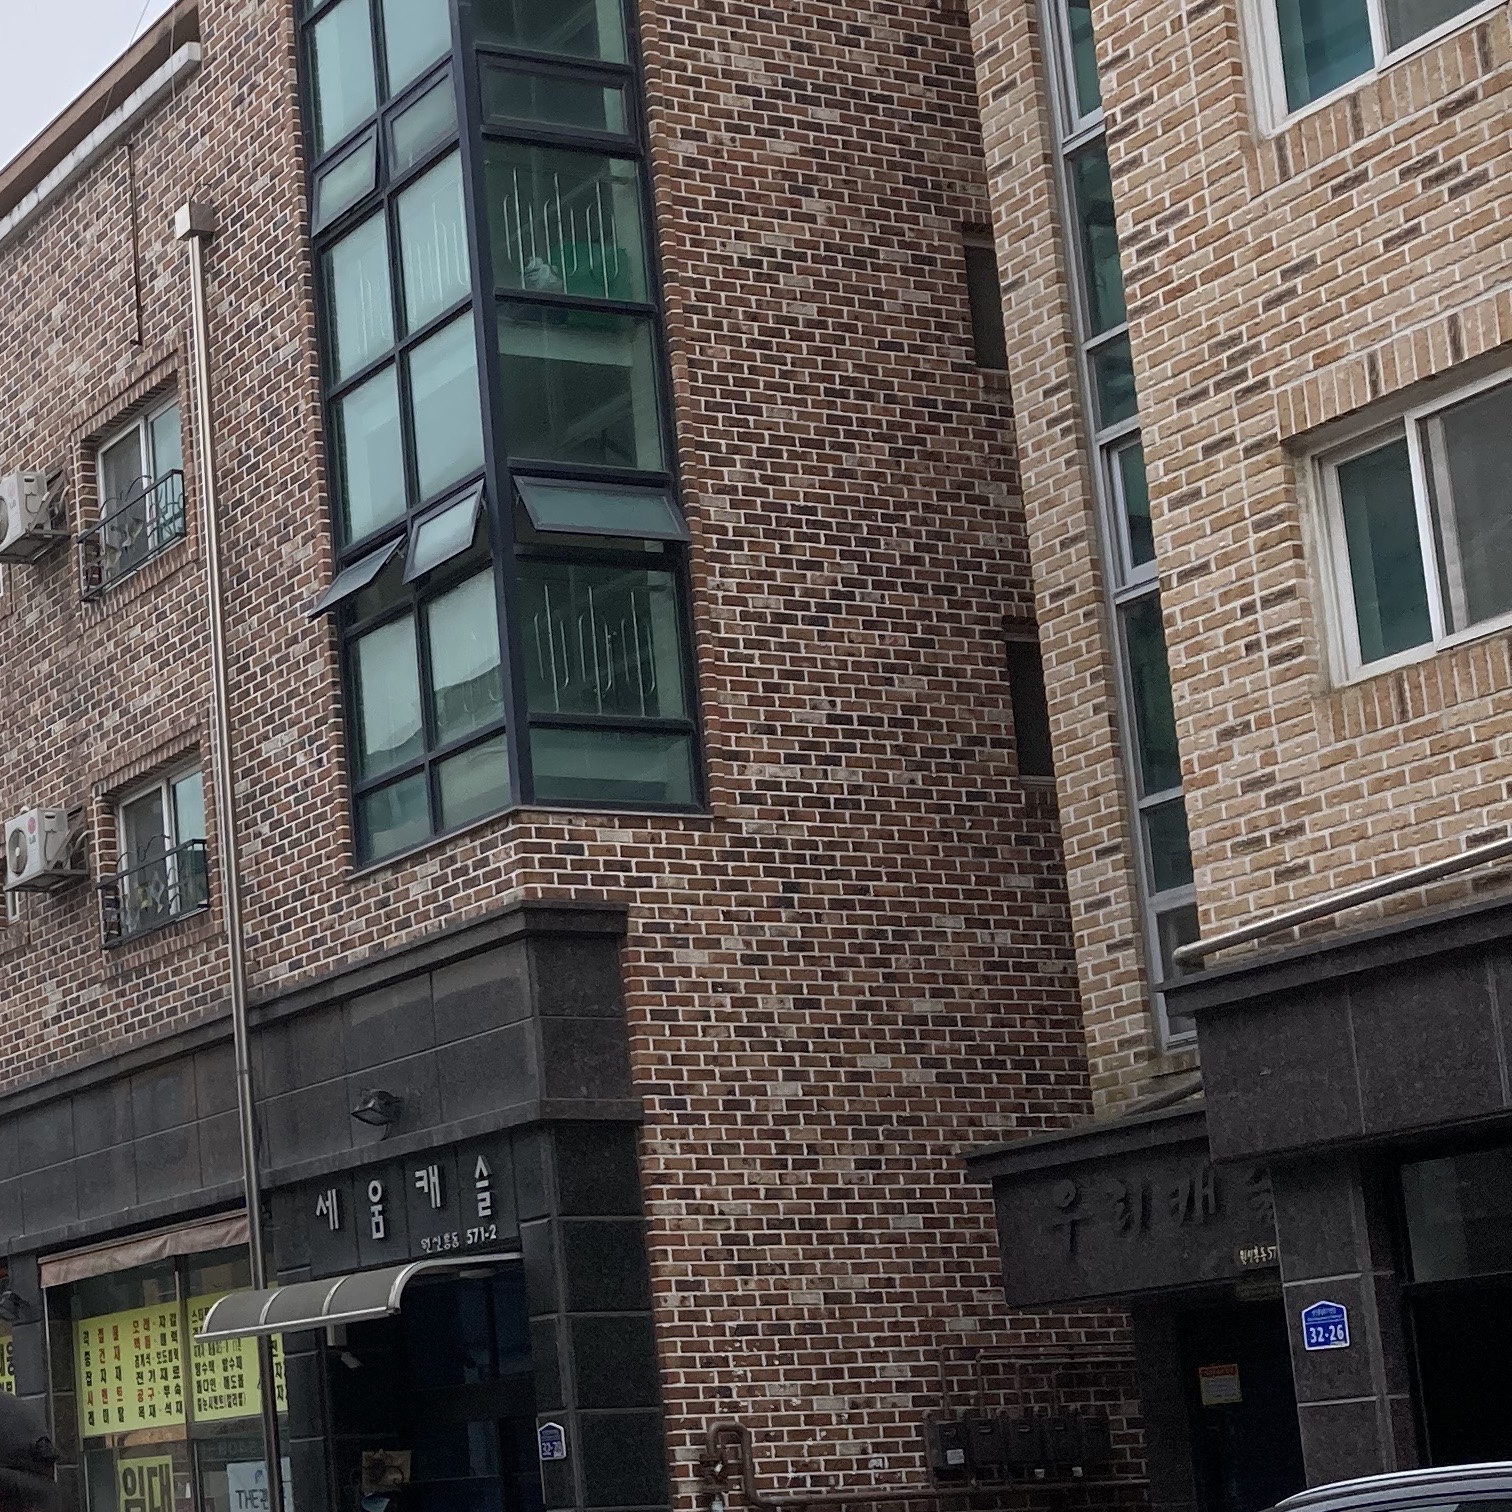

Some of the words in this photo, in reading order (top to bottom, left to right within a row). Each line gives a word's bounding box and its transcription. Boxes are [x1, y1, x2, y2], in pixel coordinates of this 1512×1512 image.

[316, 1155, 491, 1240] 세움캐슬
[466, 1224, 497, 1245] 571-2
[1309, 1324, 1344, 1343] 32-26
